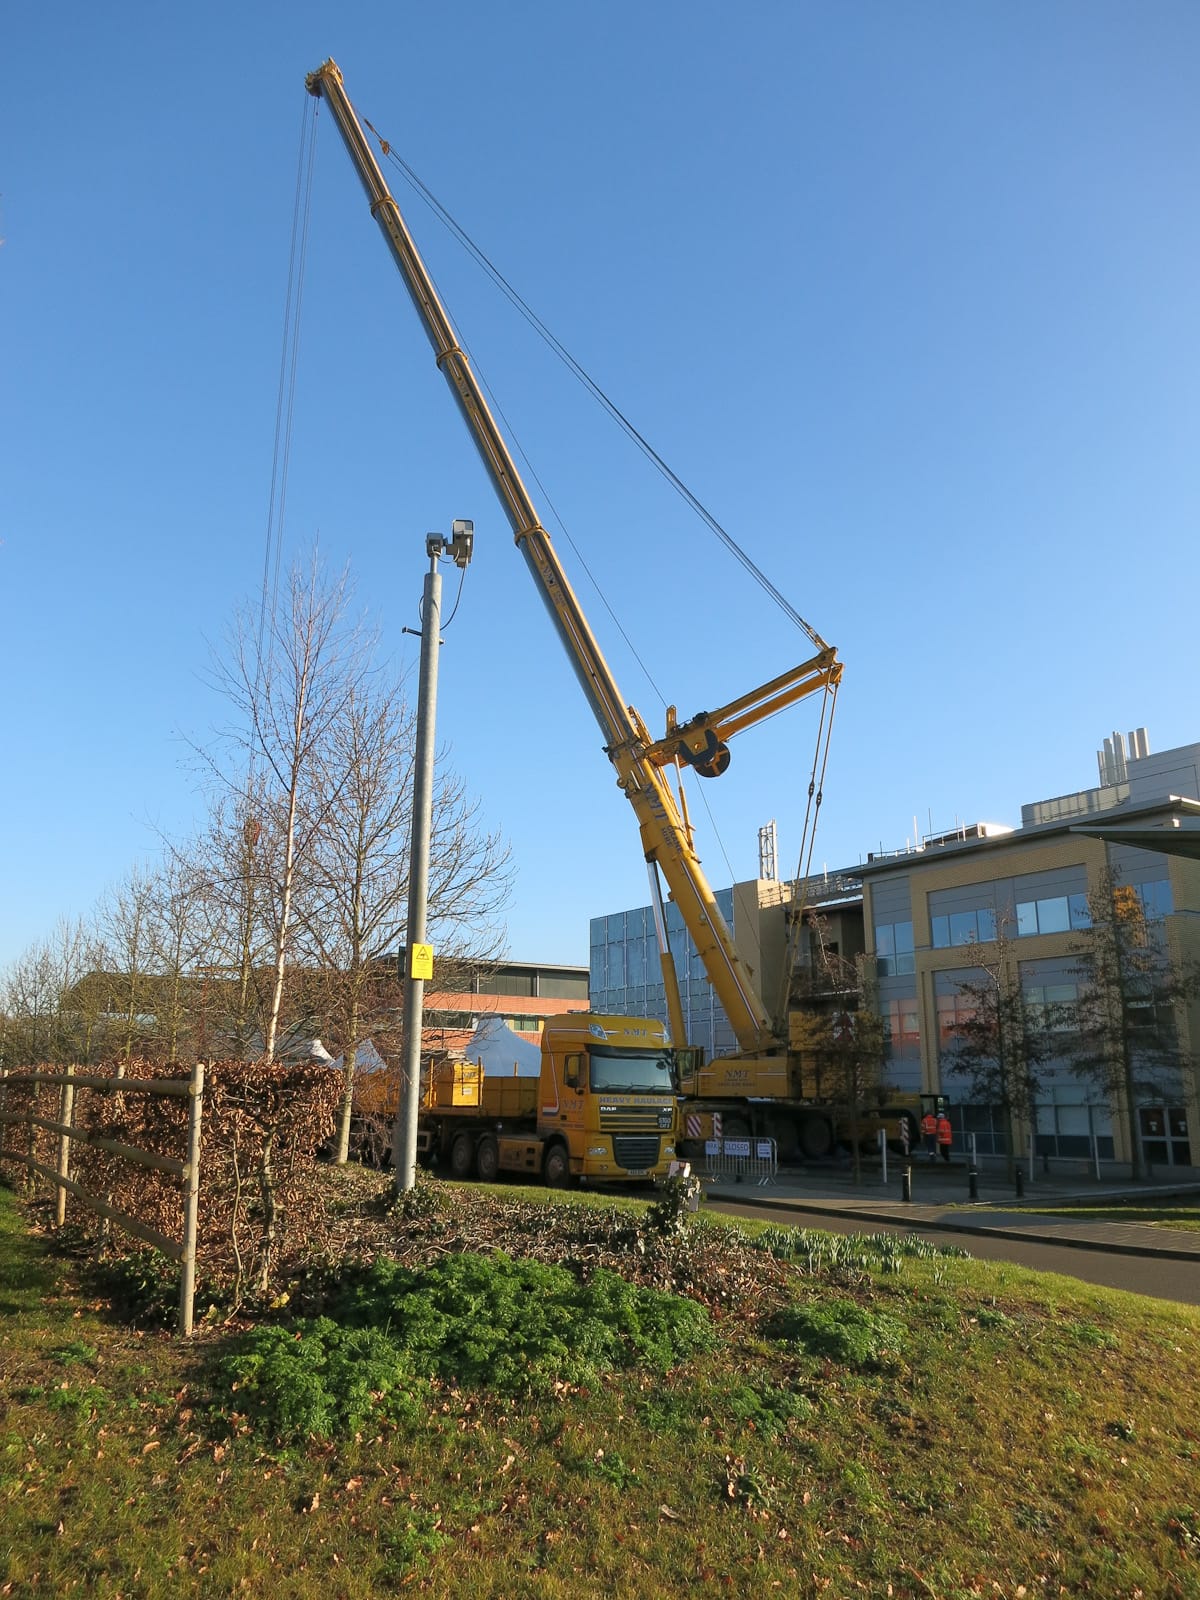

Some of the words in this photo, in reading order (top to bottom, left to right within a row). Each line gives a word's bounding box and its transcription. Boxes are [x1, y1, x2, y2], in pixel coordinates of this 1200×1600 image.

[644, 782, 668, 819] NMT
[623, 1028, 648, 1038] NMT
[600, 1096, 631, 1104] HEAVY
[634, 1097, 673, 1105] HAULAGE
[724, 1143, 749, 1151] CLOSED
